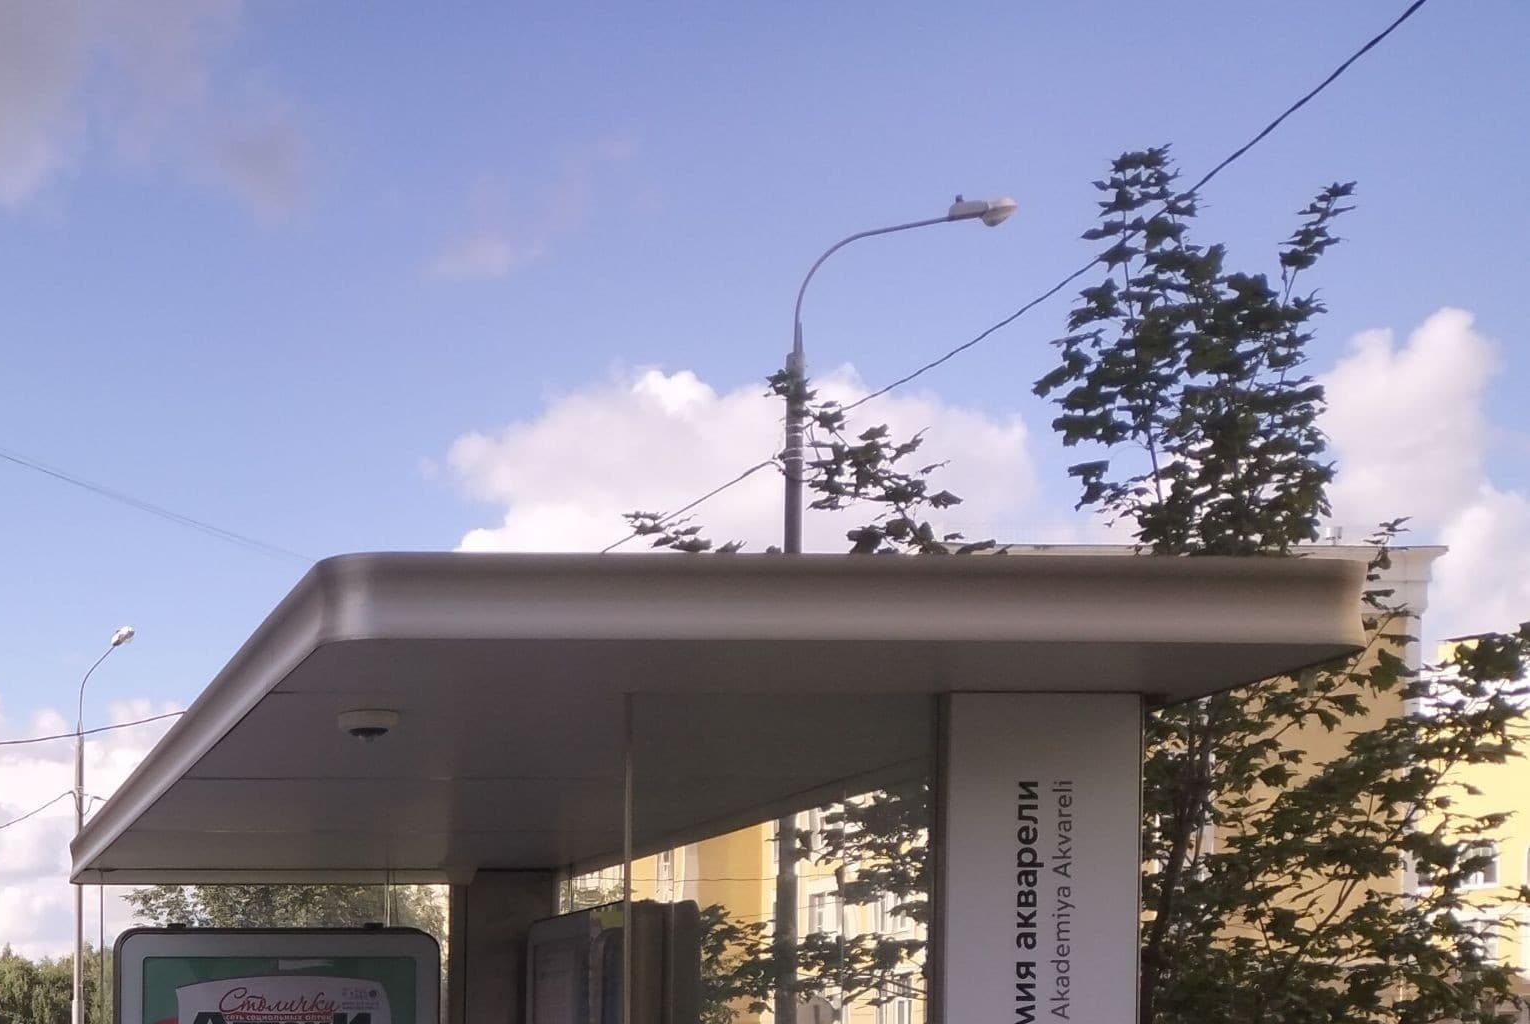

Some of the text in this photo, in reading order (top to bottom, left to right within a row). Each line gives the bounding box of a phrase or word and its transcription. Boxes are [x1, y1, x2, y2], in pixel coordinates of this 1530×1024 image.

[1016, 780, 1044, 950] акварели
[1050, 780, 1076, 1020] Akademiya Akvareli
[219, 987, 339, 1012] Столички
